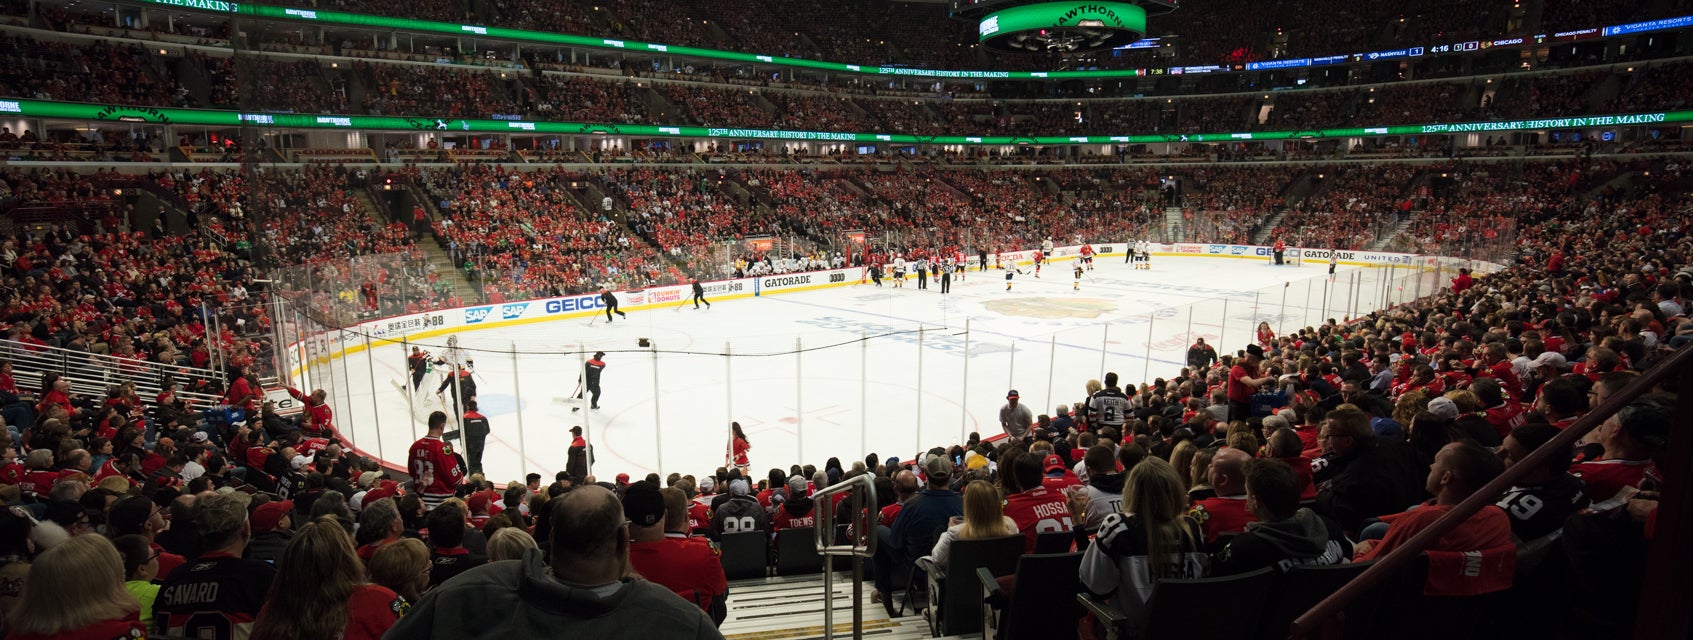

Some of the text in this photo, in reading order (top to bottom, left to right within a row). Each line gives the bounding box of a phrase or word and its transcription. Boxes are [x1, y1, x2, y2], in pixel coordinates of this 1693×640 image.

[186, 0, 238, 13] MAKING
[1053, 5, 1125, 27] AWTHORN
[1658, 17, 1692, 25] RESORTS
[1493, 38, 1523, 46] CHICAGO
[1430, 45, 1449, 53] 4:16
[1422, 113, 1665, 133] 125TH ANNIVERSARY: HISTORY IN THE MAKING
[708, 128, 728, 136] 125TH
[780, 130, 808, 139] HISTORY
[1304, 250, 1355, 260] GATOADE
[1364, 255, 1400, 263] UNITED
[734, 282, 743, 292] 88
[764, 275, 811, 288] GATORADE
[656, 295, 680, 303] DONUTS
[466, 309, 488, 321] SAP
[503, 304, 525, 317] SAP
[432, 315, 444, 326] 88
[1104, 406, 1115, 421] 2
[1032, 501, 1069, 519] HOSSA
[789, 516, 814, 528] TOEWS
[163, 581, 220, 607] SAVARD
